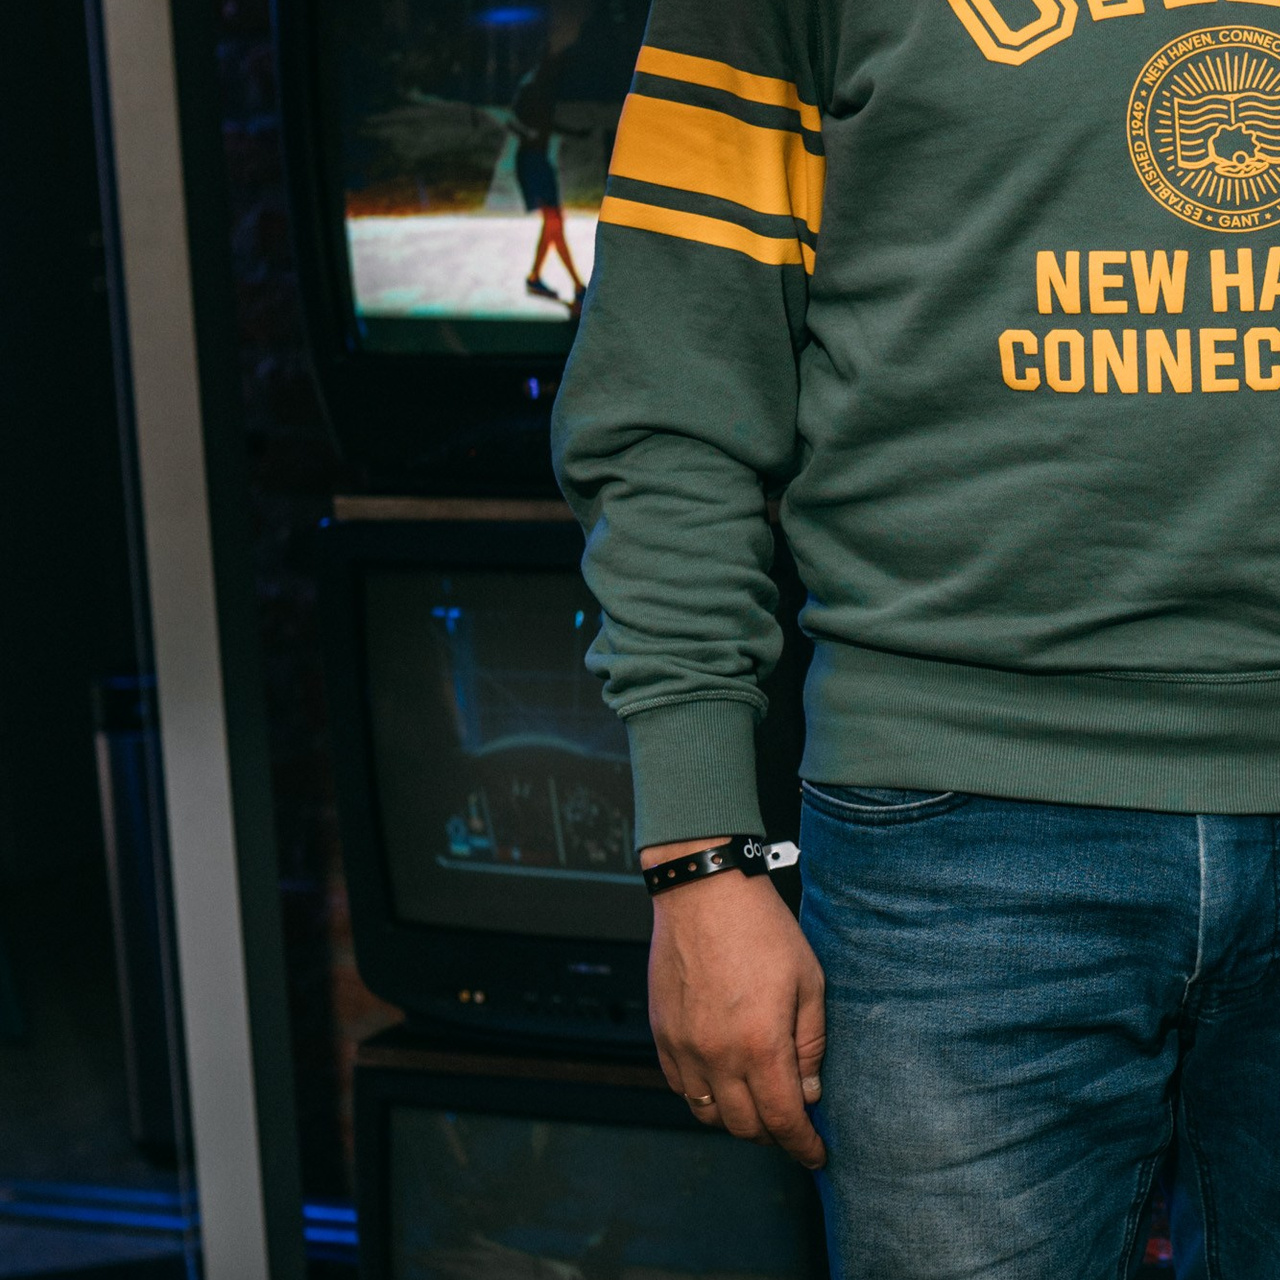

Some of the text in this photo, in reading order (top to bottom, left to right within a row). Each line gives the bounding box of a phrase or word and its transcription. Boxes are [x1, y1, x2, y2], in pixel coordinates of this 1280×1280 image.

[1143, 55, 1170, 86] NEW
[1167, 32, 1216, 61] HAVEN,
[1132, 101, 1203, 221] ESTABLISHED 1949
[1218, 213, 1261, 228] GANT
[1036, 249, 1189, 315] NEW
[743, 838, 763, 859] do
